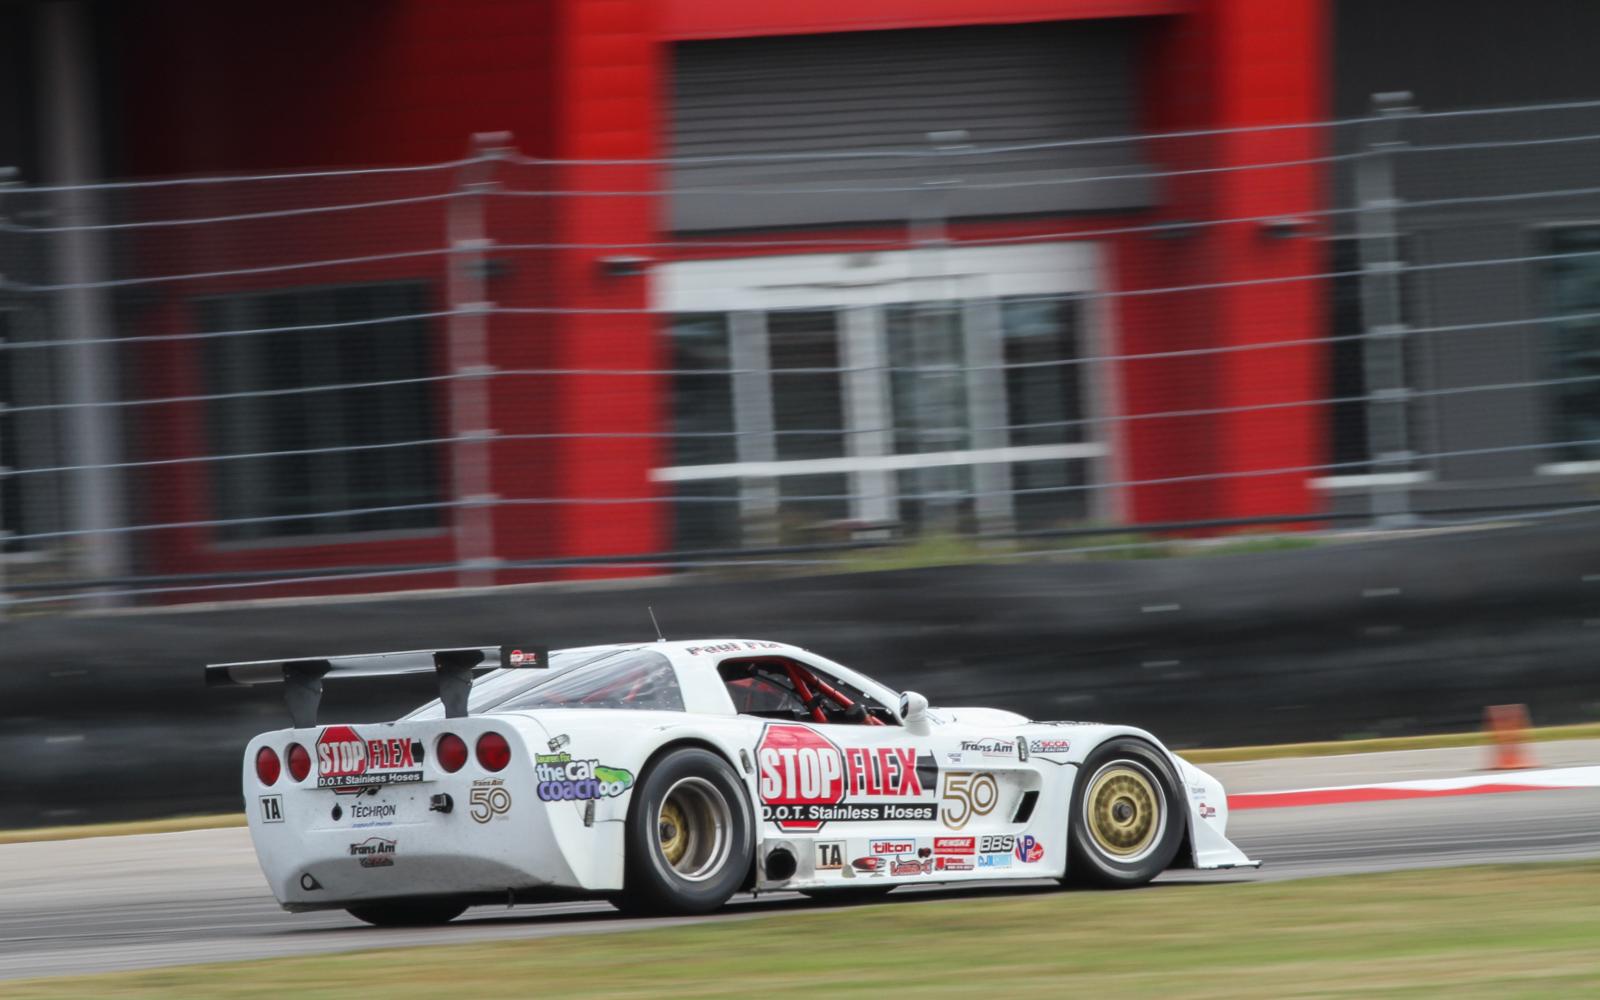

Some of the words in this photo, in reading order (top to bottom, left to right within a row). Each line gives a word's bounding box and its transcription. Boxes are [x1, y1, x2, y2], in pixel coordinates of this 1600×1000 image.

[686, 642, 741, 656] Paul
[318, 740, 366, 775] STOP
[368, 738, 414, 770] FLEX
[961, 741, 991, 752] Trans
[993, 741, 1013, 752] Am
[319, 777, 344, 787] D.O.T.
[346, 775, 386, 785] Stainless
[389, 772, 420, 782] Hoses
[537, 763, 565, 782] the
[565, 760, 598, 781] car
[760, 747, 841, 800] STOP
[844, 747, 922, 796] FLEX
[262, 798, 281, 820] TA
[470, 787, 512, 824] 50
[942, 771, 999, 830] 50
[351, 804, 396, 819] TECHRON
[762, 806, 804, 820] D.O.T.
[809, 805, 879, 819] Stainless
[884, 804, 932, 819] Hoses
[350, 843, 376, 856] Trans
[378, 842, 395, 854] Am
[873, 842, 912, 854] tilton
[980, 835, 1014, 853] BBS
[1016, 835, 1035, 863] VP
[819, 844, 843, 867] TA
